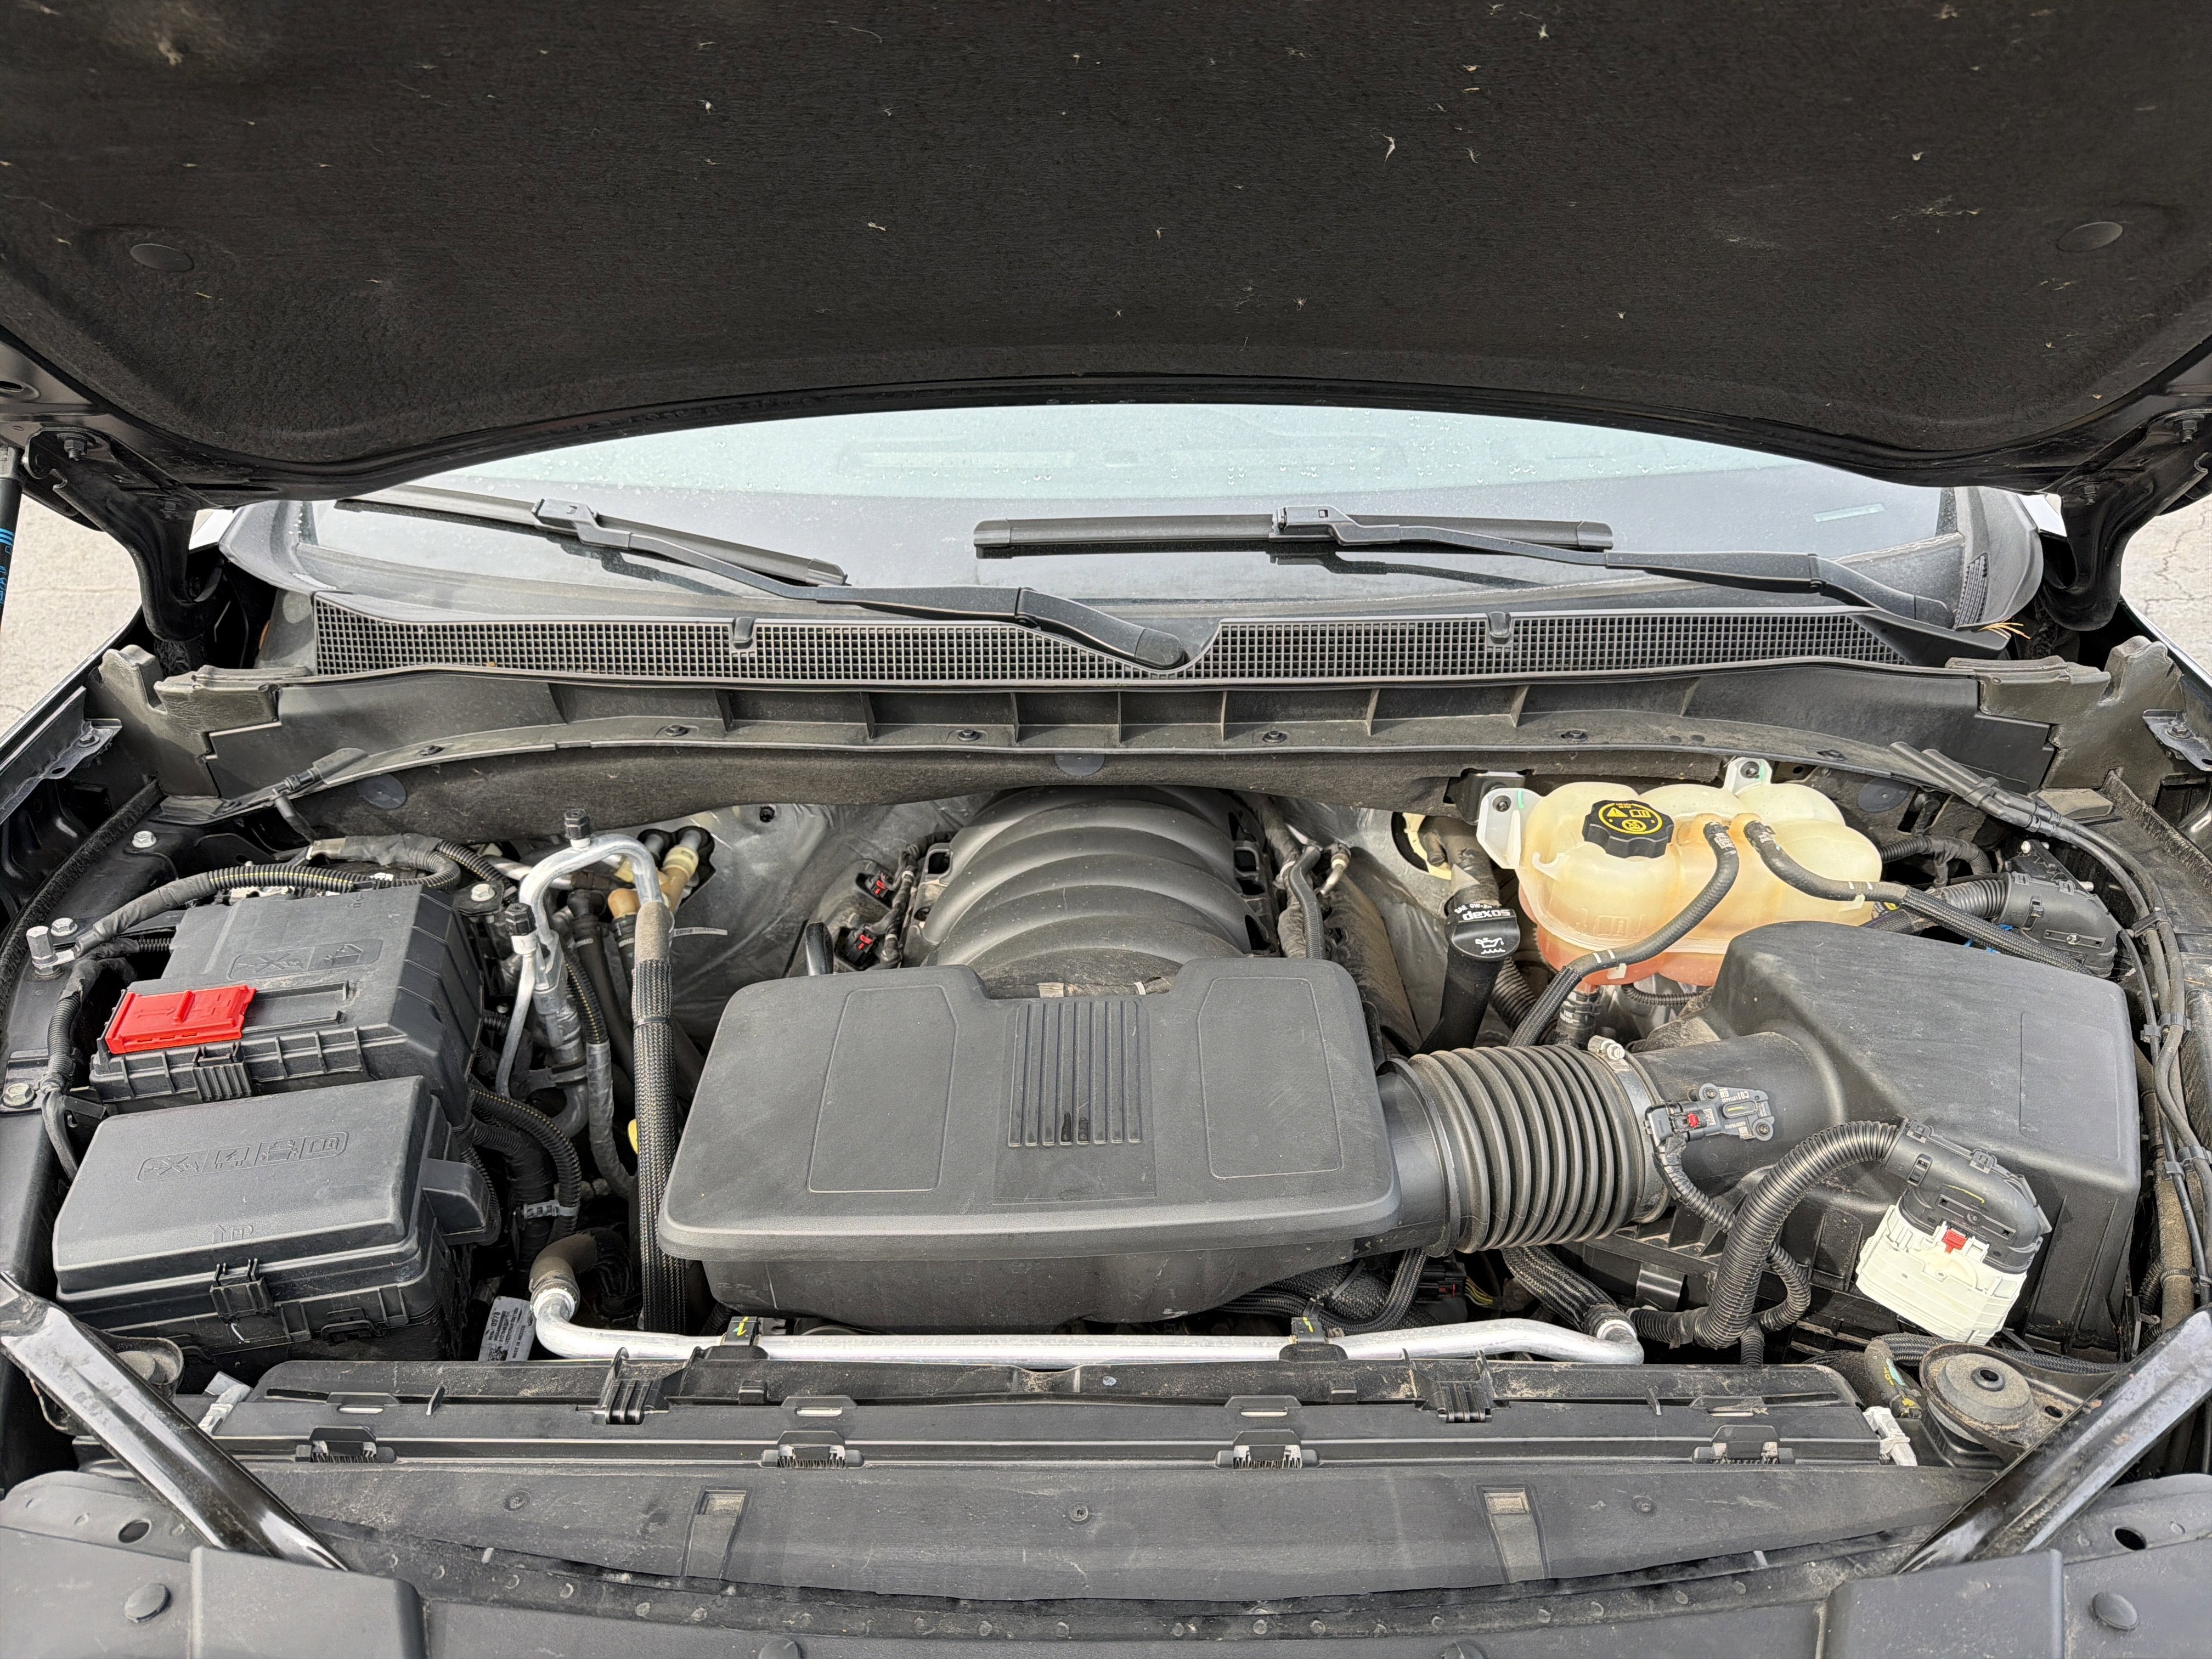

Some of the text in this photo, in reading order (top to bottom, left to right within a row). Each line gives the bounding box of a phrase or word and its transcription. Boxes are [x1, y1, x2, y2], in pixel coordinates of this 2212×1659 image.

[1454, 905, 1468, 913] SAE
[1462, 909, 1511, 921] dexos
[1719, 1090, 1729, 1098] GM
[490, 1312, 500, 1327] 0978
